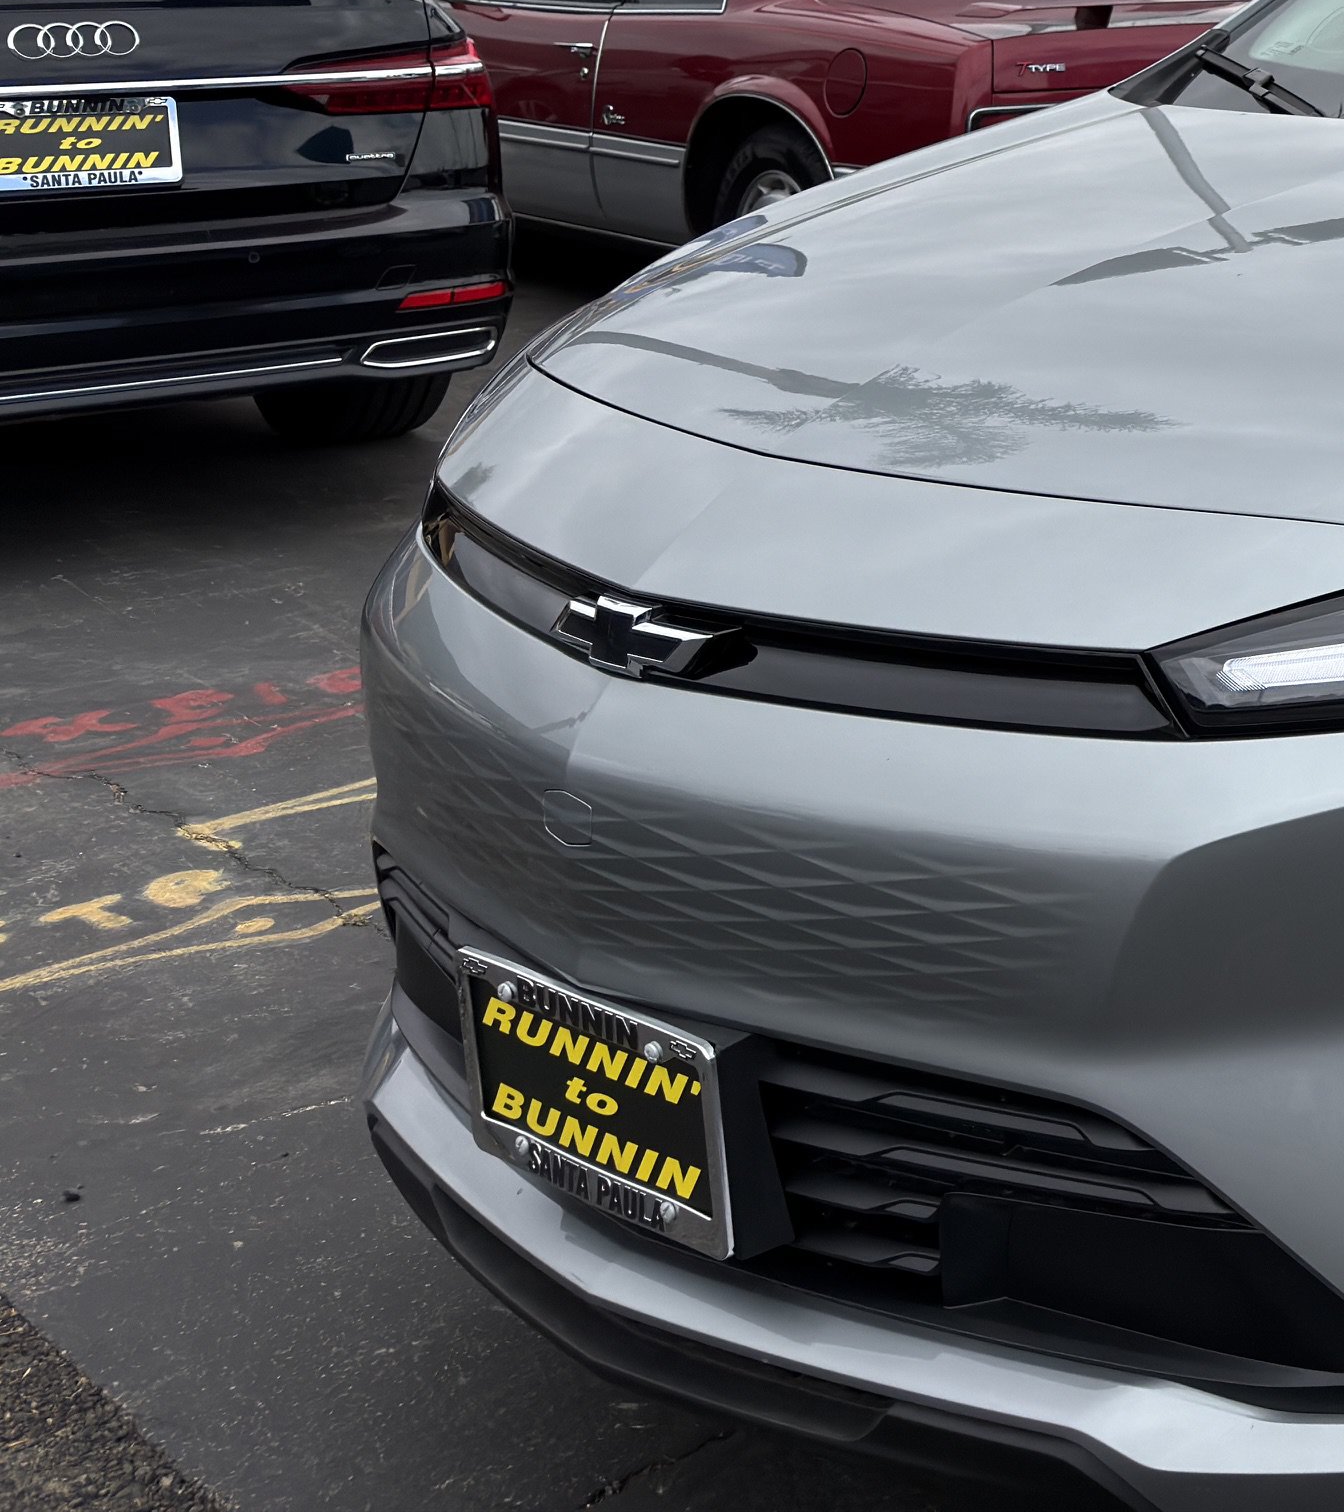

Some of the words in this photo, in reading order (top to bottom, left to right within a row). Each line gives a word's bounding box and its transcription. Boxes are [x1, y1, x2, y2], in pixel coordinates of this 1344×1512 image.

[29, 98, 125, 114] BUNNIN
[59, 136, 102, 149] to
[0, 152, 159, 174] BUNNIN
[30, 173, 82, 188] SANTA
[88, 170, 138, 185] PAULA
[517, 975, 638, 1050] BUNNIN
[482, 996, 702, 1105] RUNNIN'
[564, 1076, 618, 1116] to
[492, 1082, 702, 1199] BUNNIN
[527, 1141, 590, 1201] SANTA
[598, 1173, 665, 1232] PAULA
